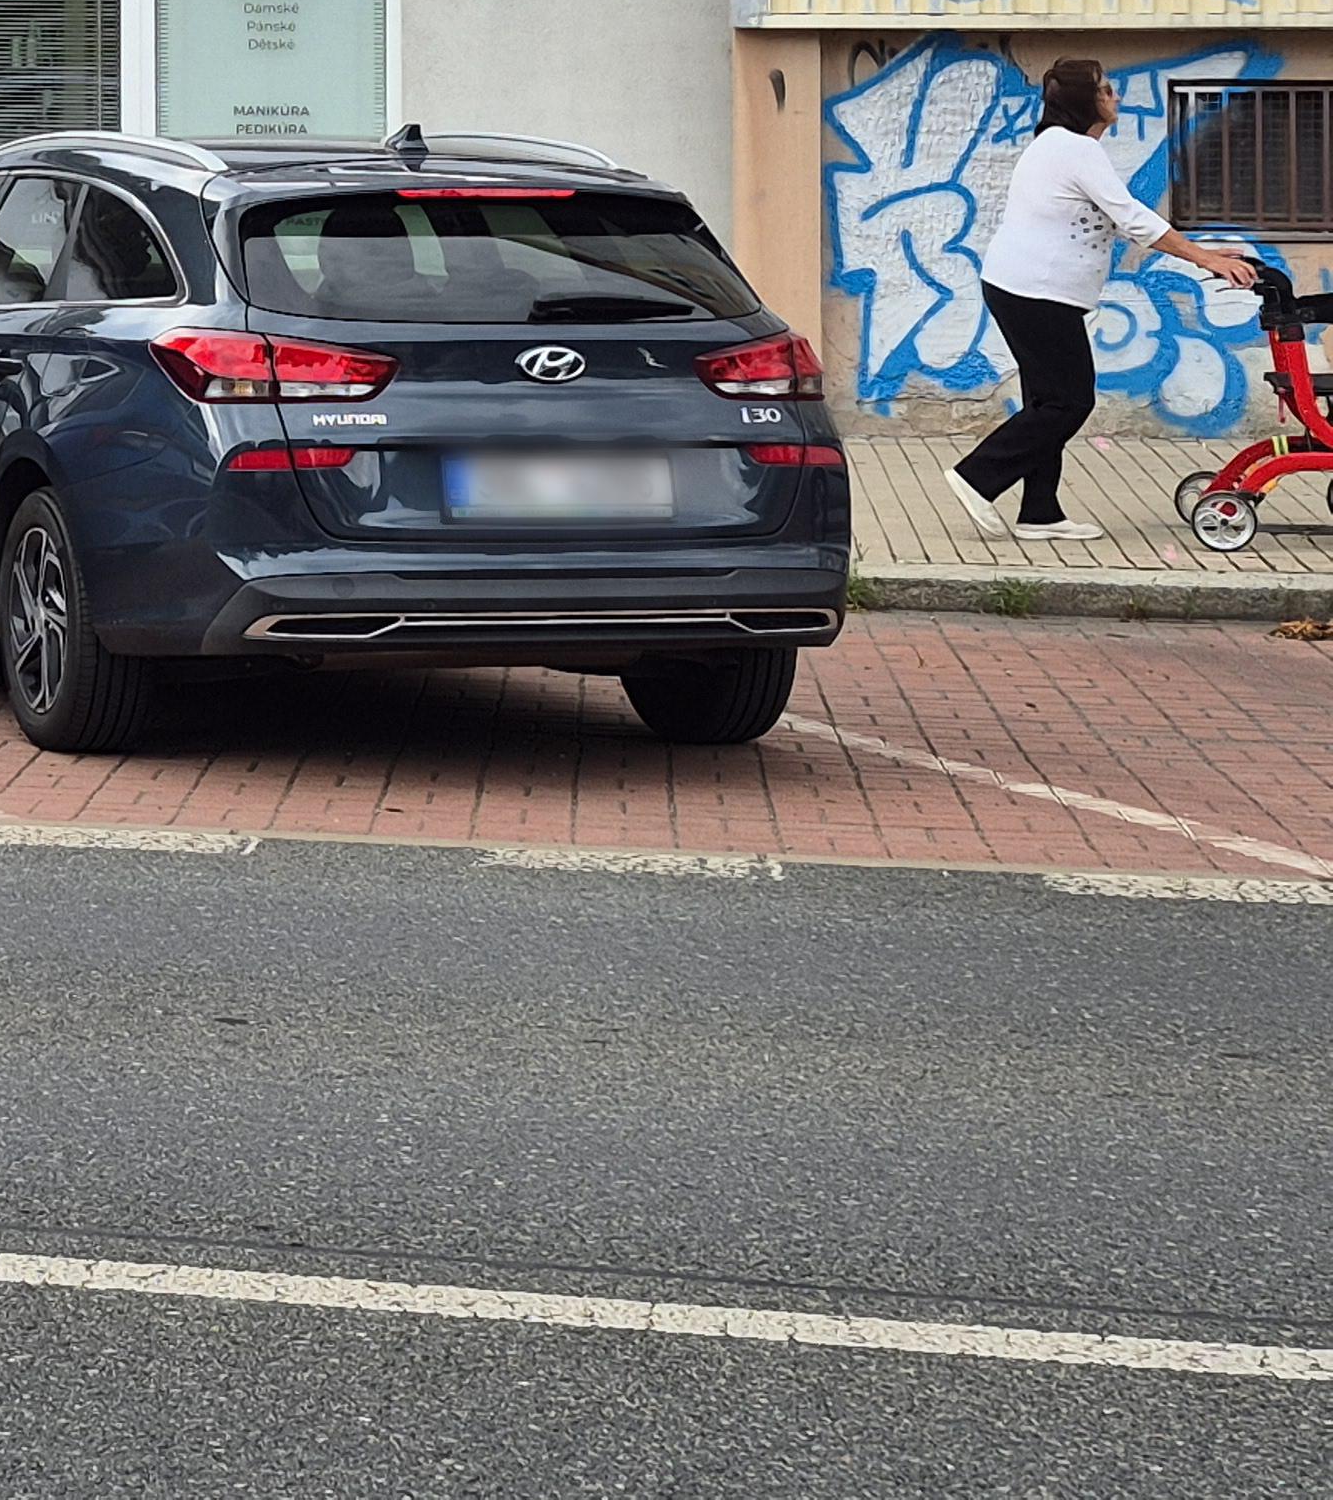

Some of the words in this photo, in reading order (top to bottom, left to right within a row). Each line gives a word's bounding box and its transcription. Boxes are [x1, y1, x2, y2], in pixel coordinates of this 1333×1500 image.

[233, 103, 310, 117] MANIKÚRA
[235, 121, 308, 135] PEDIKÚRA
[312, 413, 388, 427] HYUNDAI
